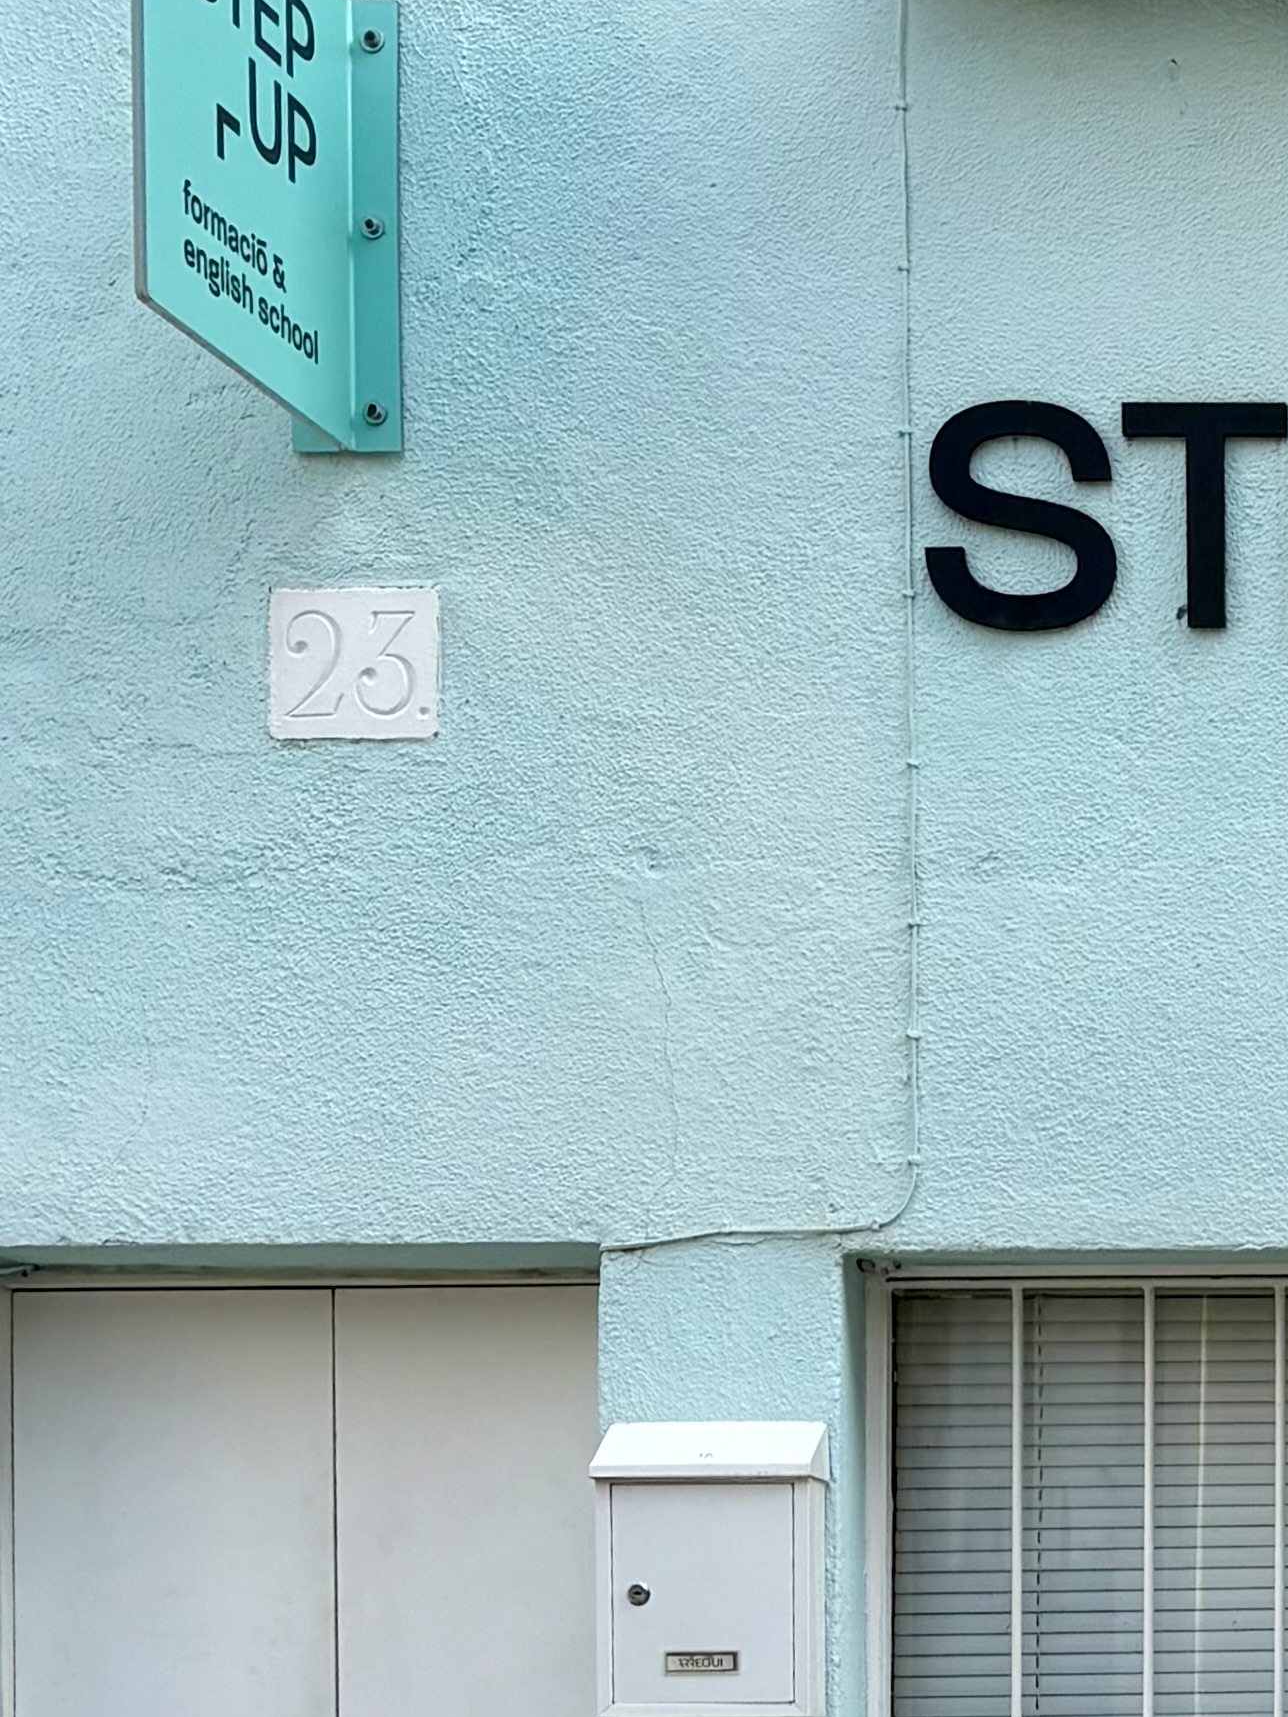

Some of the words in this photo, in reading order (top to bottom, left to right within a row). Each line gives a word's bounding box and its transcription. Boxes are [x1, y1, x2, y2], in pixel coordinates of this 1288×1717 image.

[248, 57, 317, 183] UP
[183, 179, 268, 276] formació
[272, 253, 288, 293] &
[184, 238, 254, 314] english
[258, 297, 320, 365] school
